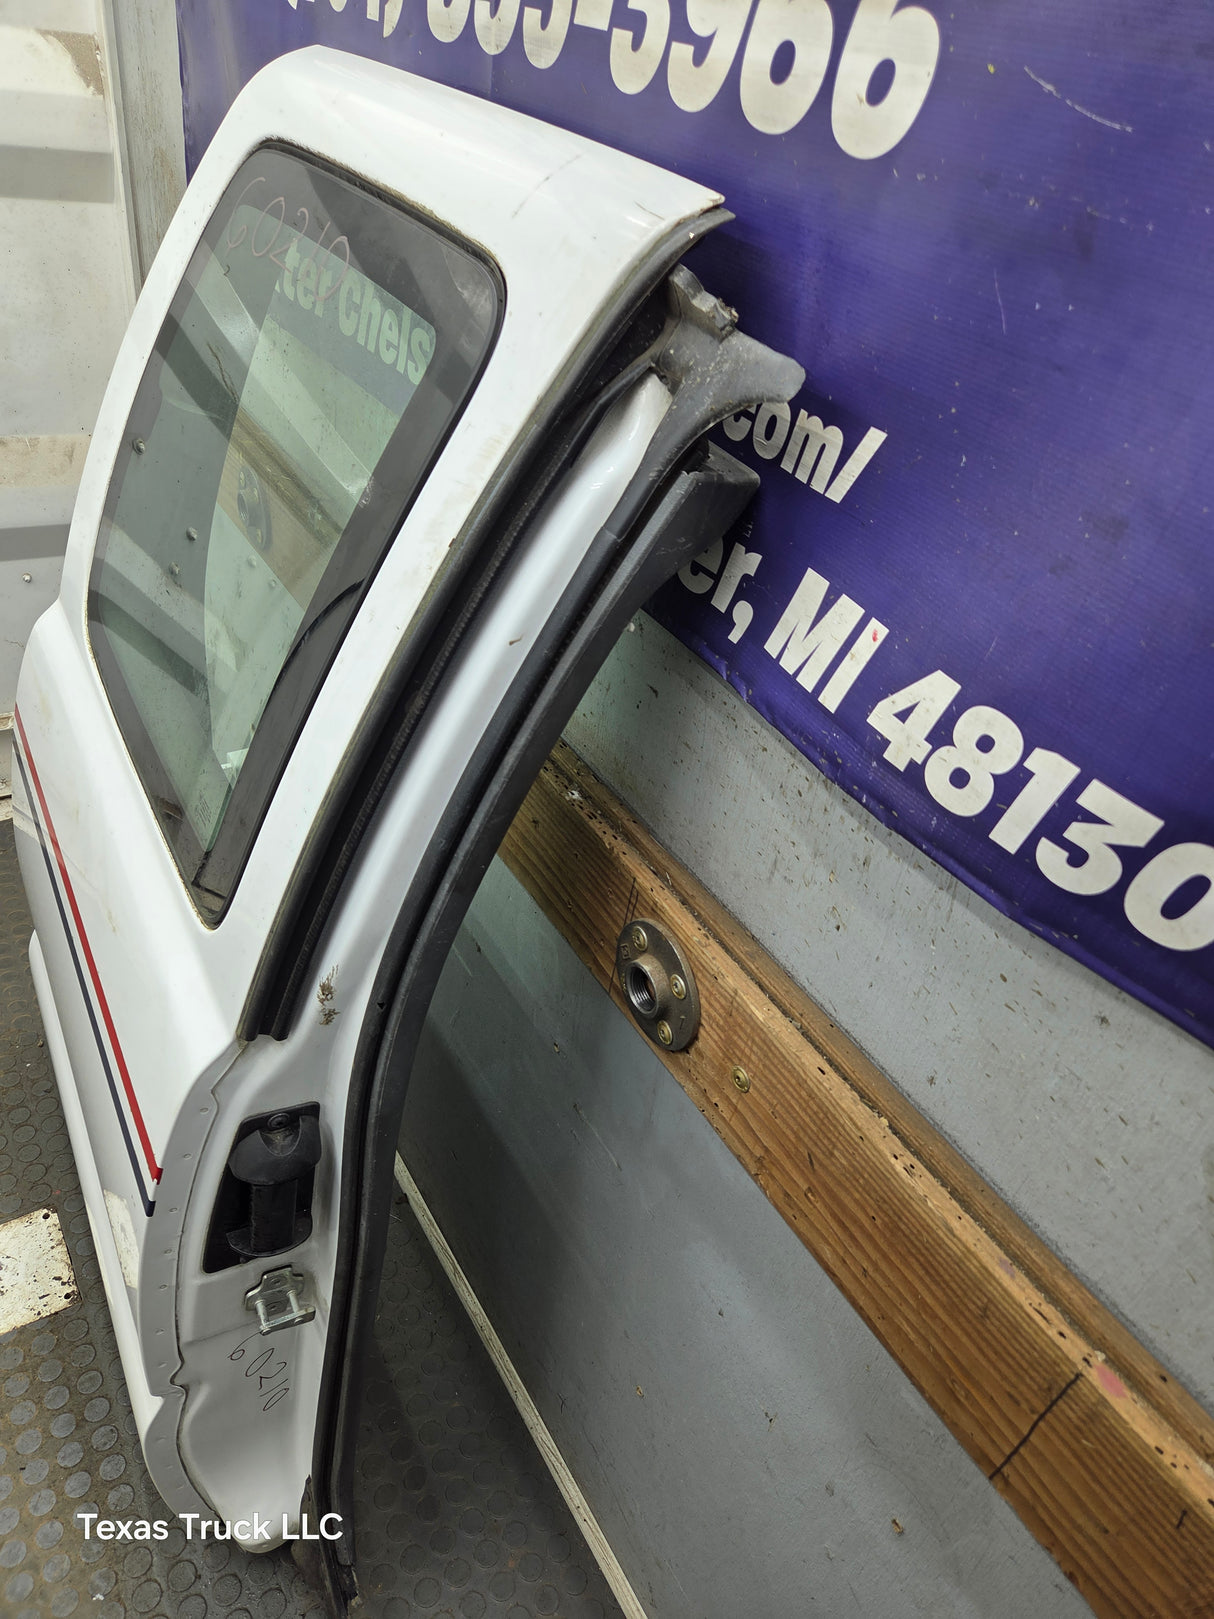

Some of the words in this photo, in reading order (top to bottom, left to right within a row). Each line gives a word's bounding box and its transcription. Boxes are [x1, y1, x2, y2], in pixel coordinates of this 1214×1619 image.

[226, 177, 350, 301] 60210
[763, 567, 889, 714] MI
[866, 669, 1214, 951] 48130
[227, 1332, 290, 1412] 60210
